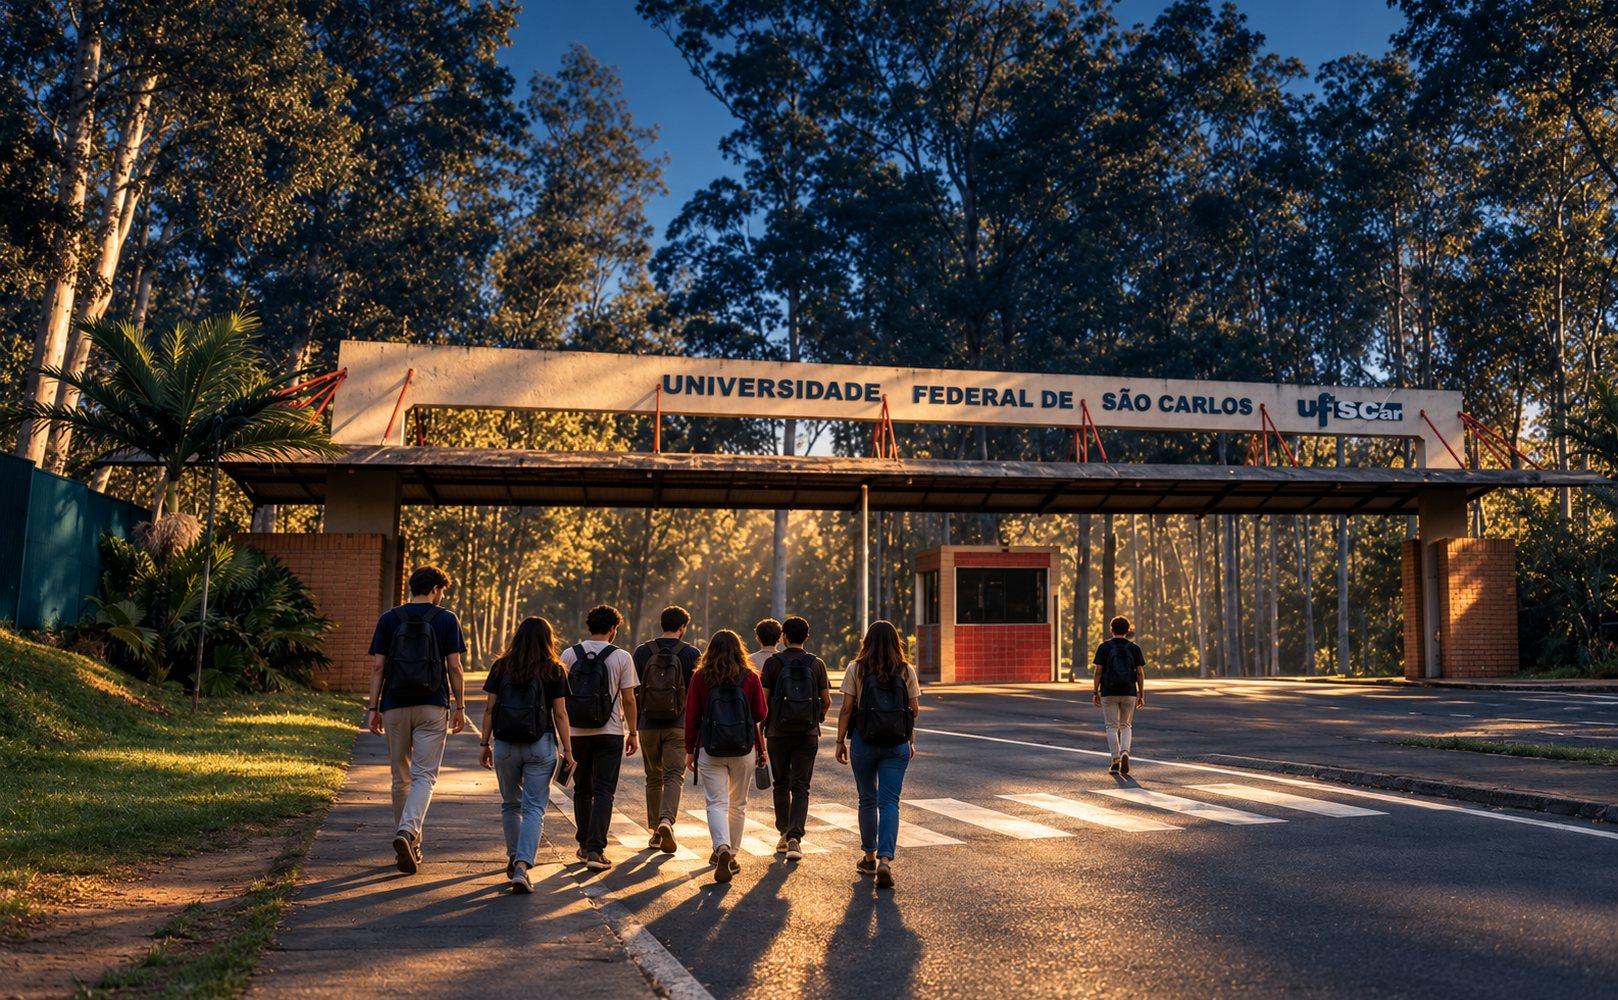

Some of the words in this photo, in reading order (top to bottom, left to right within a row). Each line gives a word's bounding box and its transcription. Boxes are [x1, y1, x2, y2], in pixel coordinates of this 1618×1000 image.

[663, 374, 881, 402] UNIVERSIDADE
[913, 385, 1034, 408] FEDERAL
[1041, 390, 1073, 409] DE
[1102, 388, 1152, 412] SÃO
[1158, 395, 1253, 416] CARLOS
